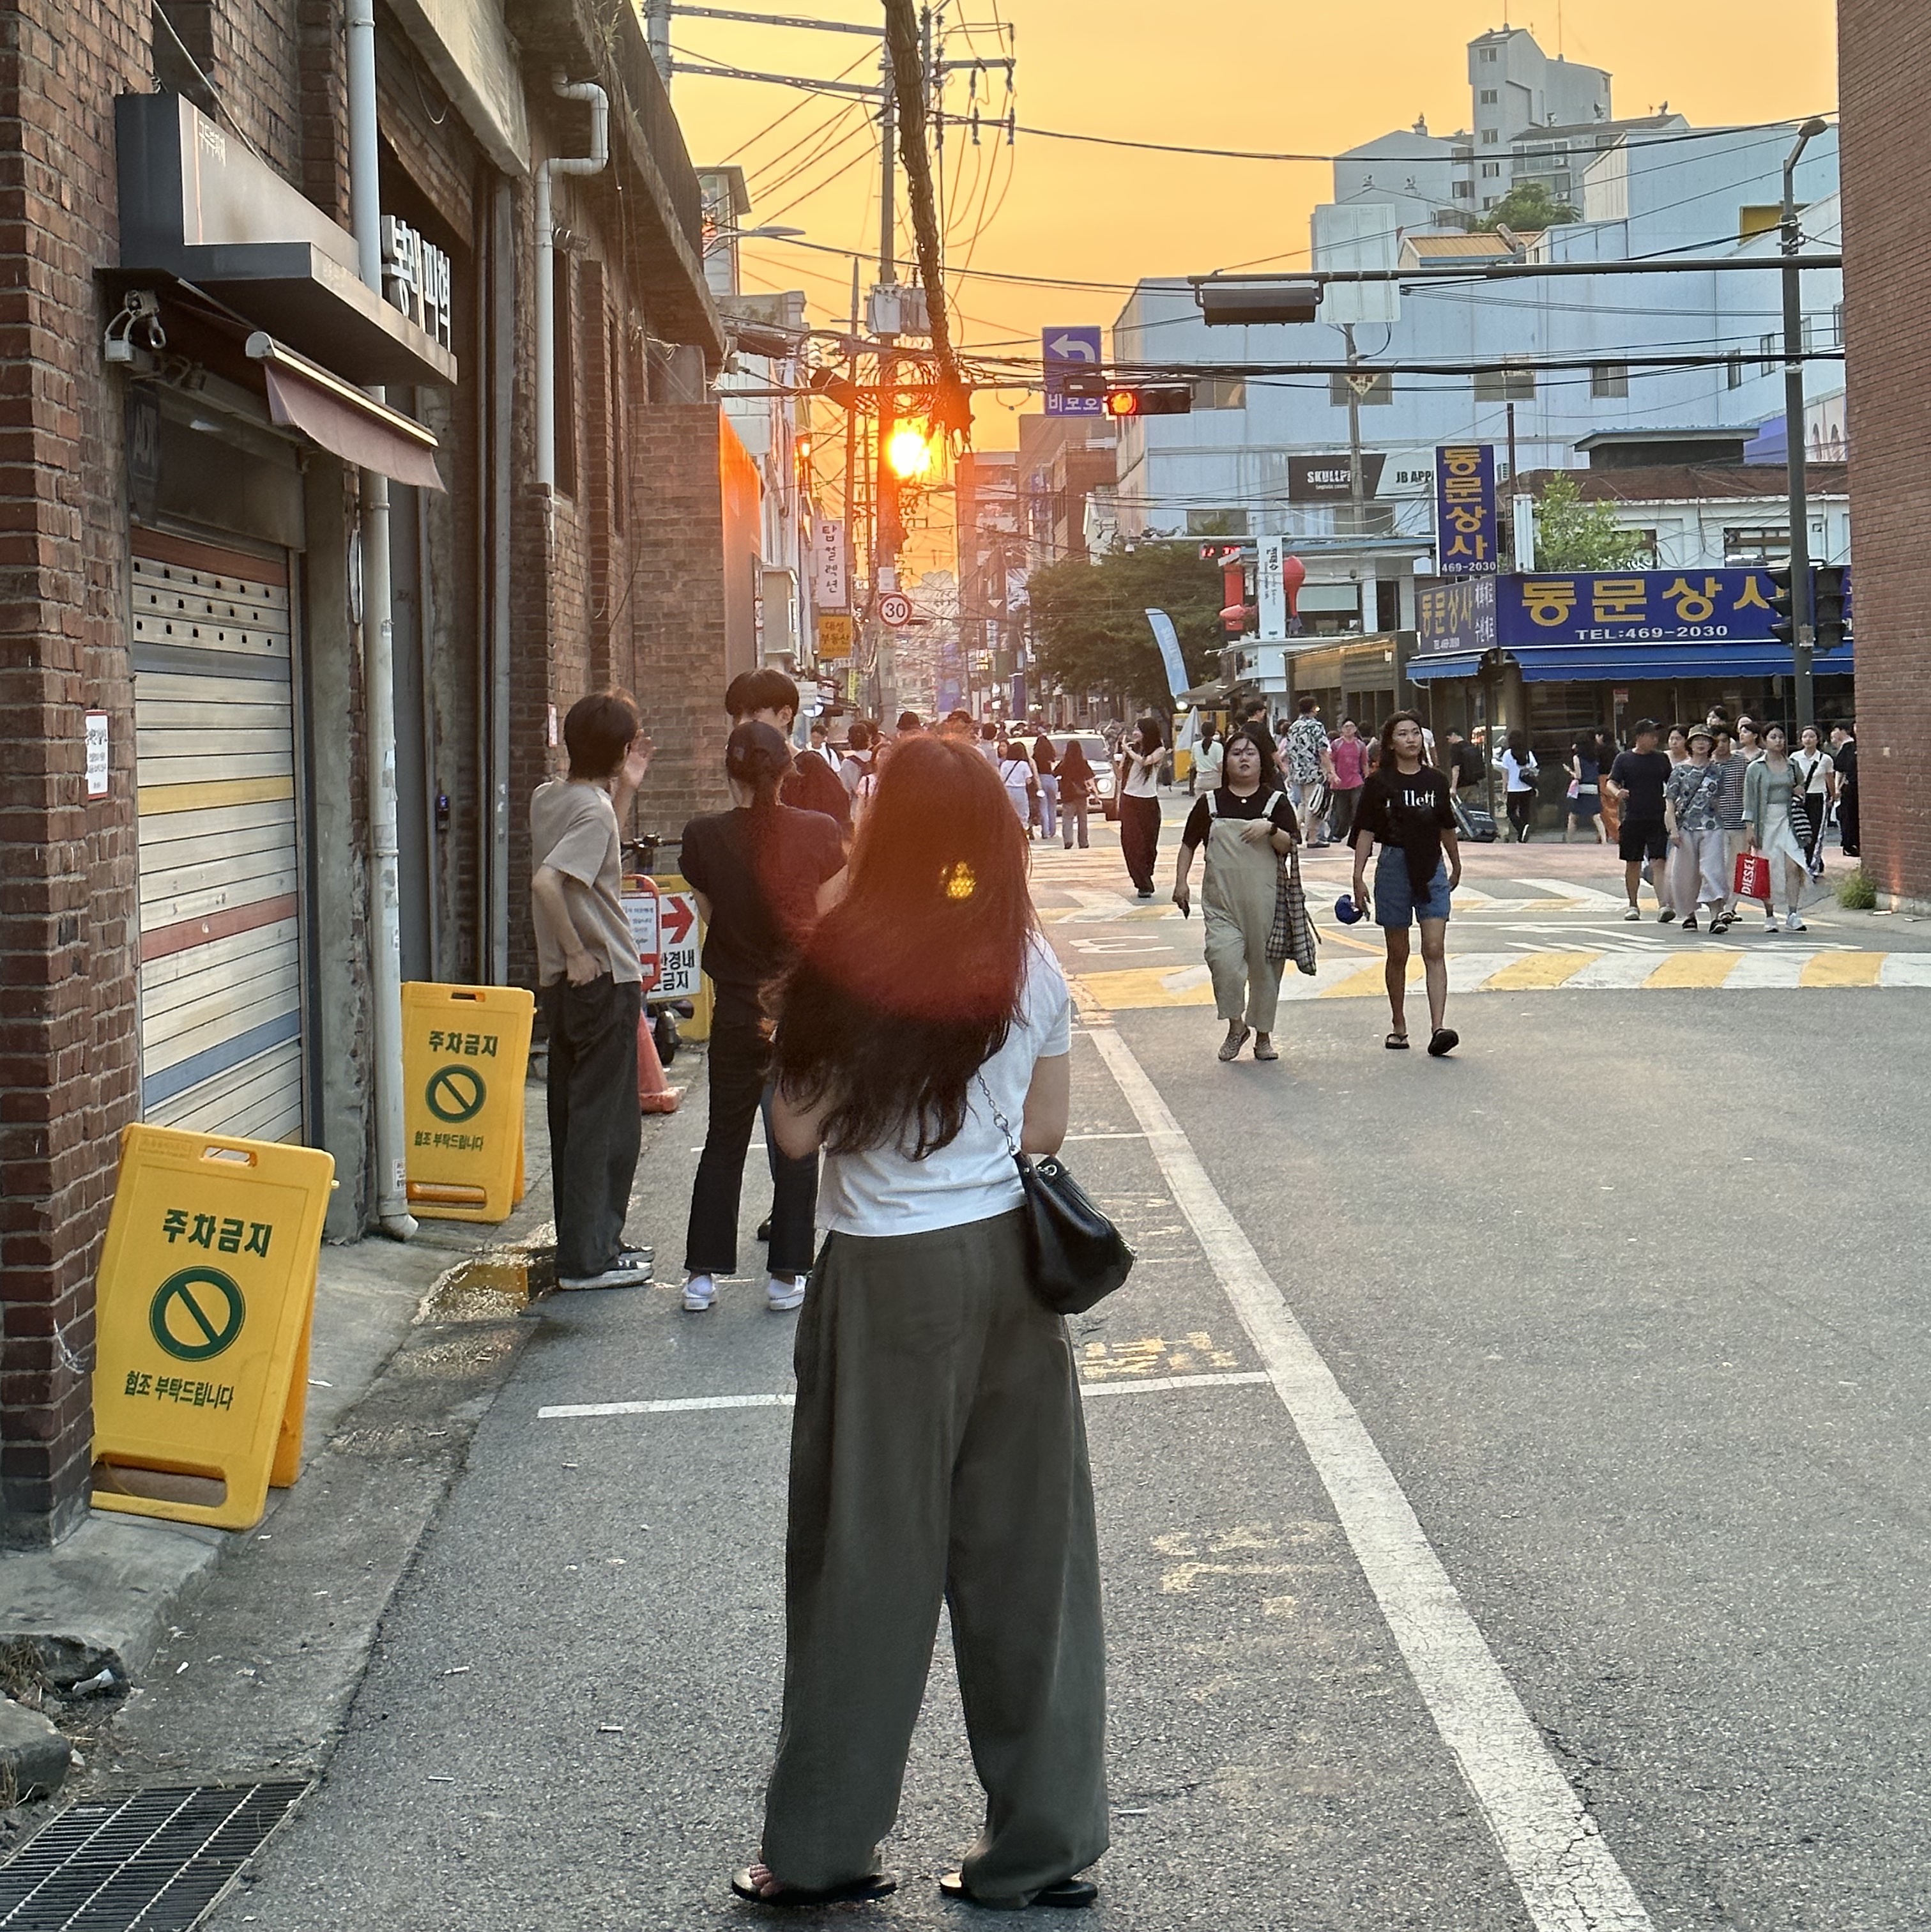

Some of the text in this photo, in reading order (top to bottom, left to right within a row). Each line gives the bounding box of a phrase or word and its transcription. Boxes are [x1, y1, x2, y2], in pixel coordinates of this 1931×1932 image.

[1396, 471, 1408, 483] JB
[1444, 448, 1488, 560] 동문상사
[1441, 562, 1497, 573] 469-2030
[885, 602, 906, 618] 30
[1422, 585, 1472, 638] 동문상사
[1741, 858, 1755, 895] DIESEL
[650, 970, 689, 992] 금지
[429, 1030, 498, 1057] 주차금지
[432, 1131, 484, 1152] 부탁드립니다
[162, 1208, 273, 1258] 주차금지
[124, 1370, 235, 1411] 협조 부탁드립니다
